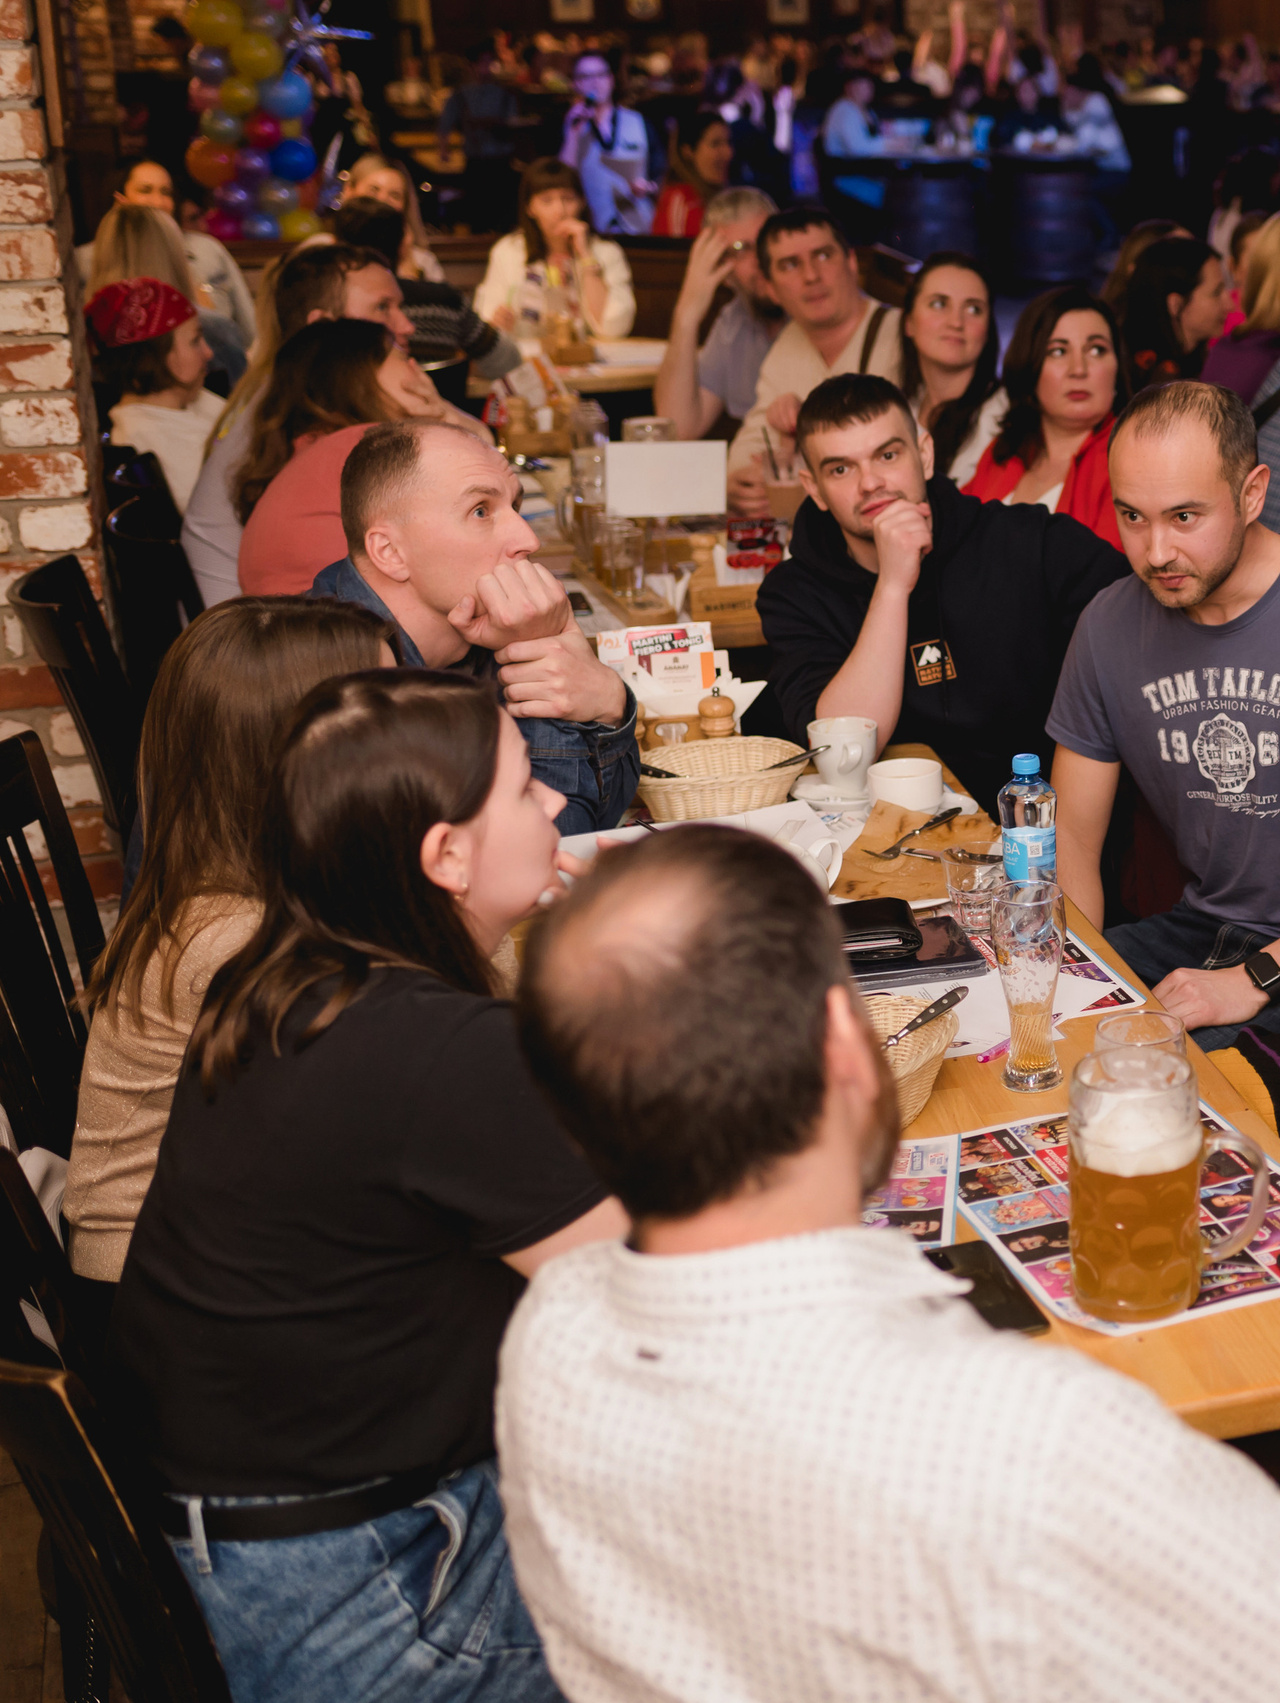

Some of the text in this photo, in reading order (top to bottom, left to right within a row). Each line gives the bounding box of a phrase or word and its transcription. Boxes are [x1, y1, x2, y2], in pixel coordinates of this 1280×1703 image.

[631, 633, 673, 649] MARTINI
[633, 635, 702, 656] FIERO & TONIC
[1141, 670, 1200, 714] TOM
[1162, 705, 1197, 720] URBAN
[1200, 699, 1249, 711] FASHION
[1157, 728, 1191, 764] 19
